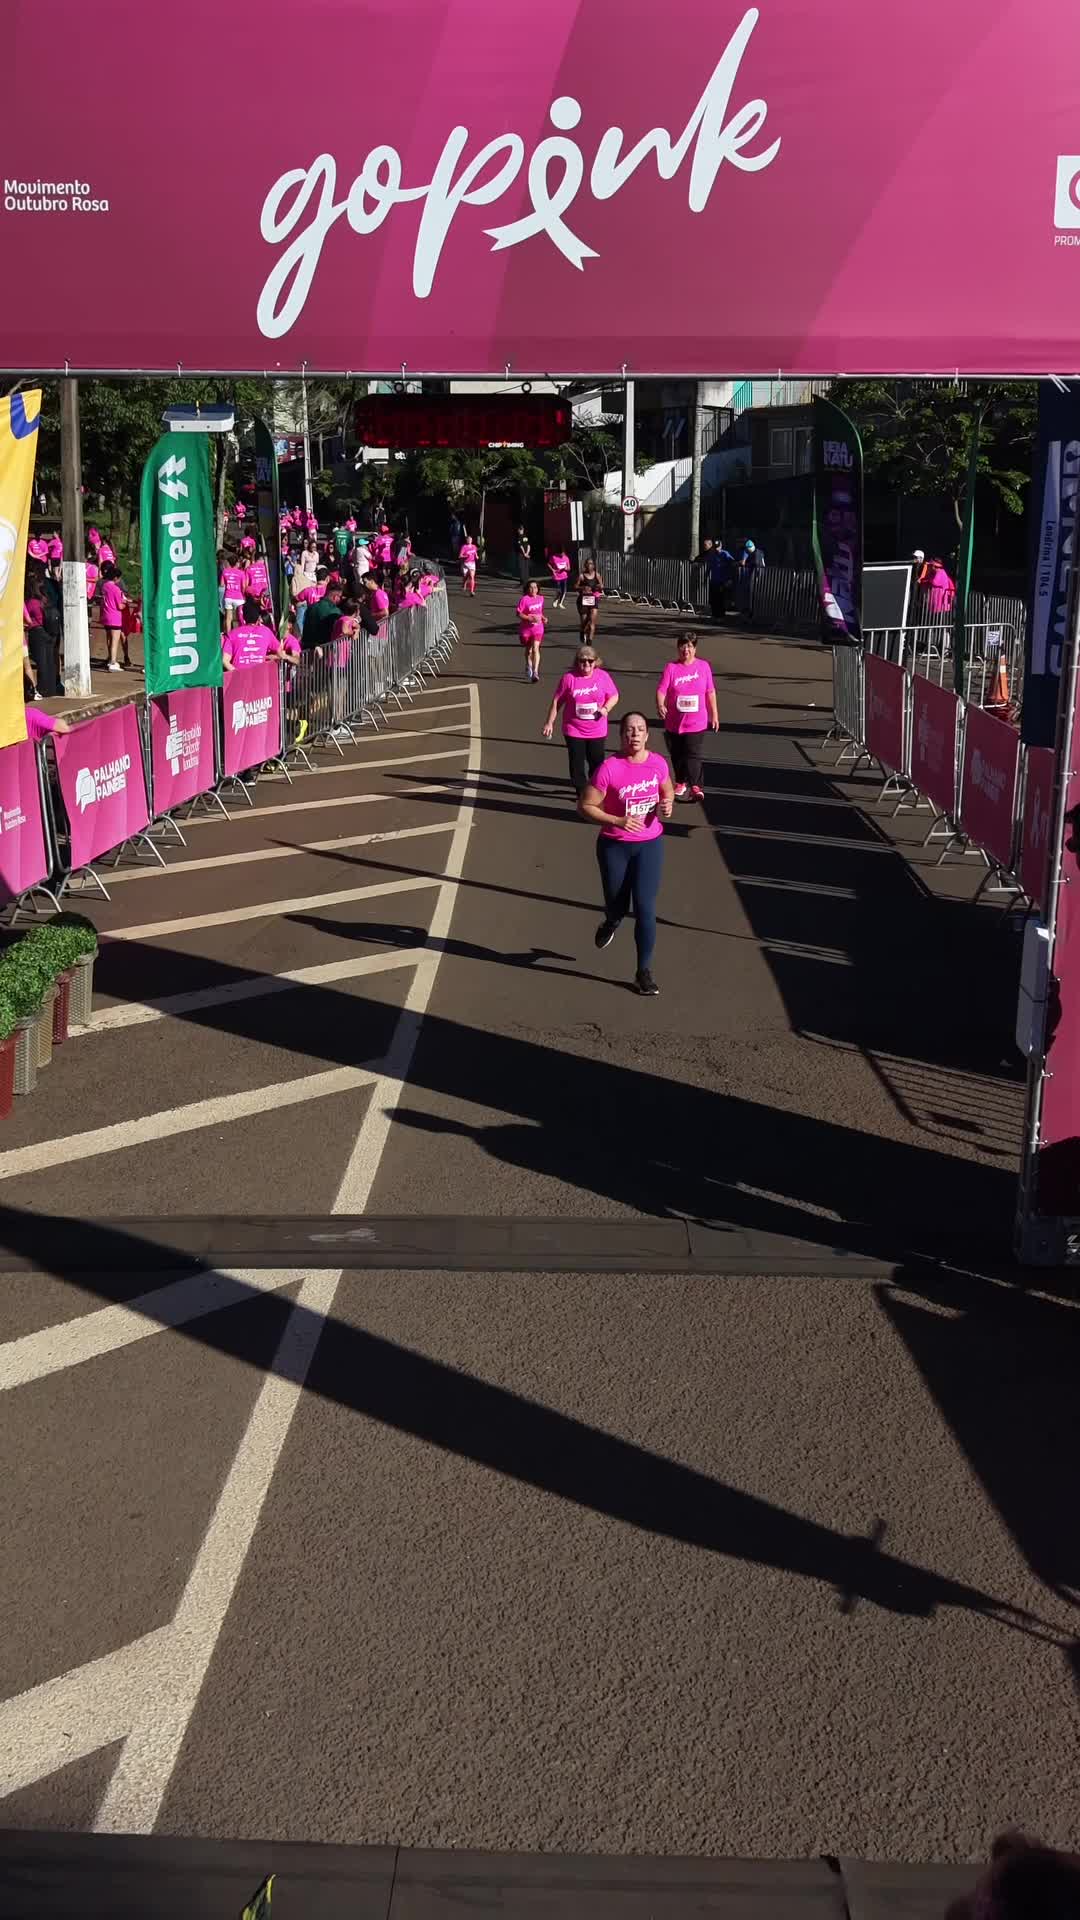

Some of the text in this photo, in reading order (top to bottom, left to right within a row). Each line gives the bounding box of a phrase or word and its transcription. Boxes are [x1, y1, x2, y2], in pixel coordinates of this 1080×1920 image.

[4, 196, 109, 211] Outubro Rosa
[162, 511, 200, 676] Unimed
